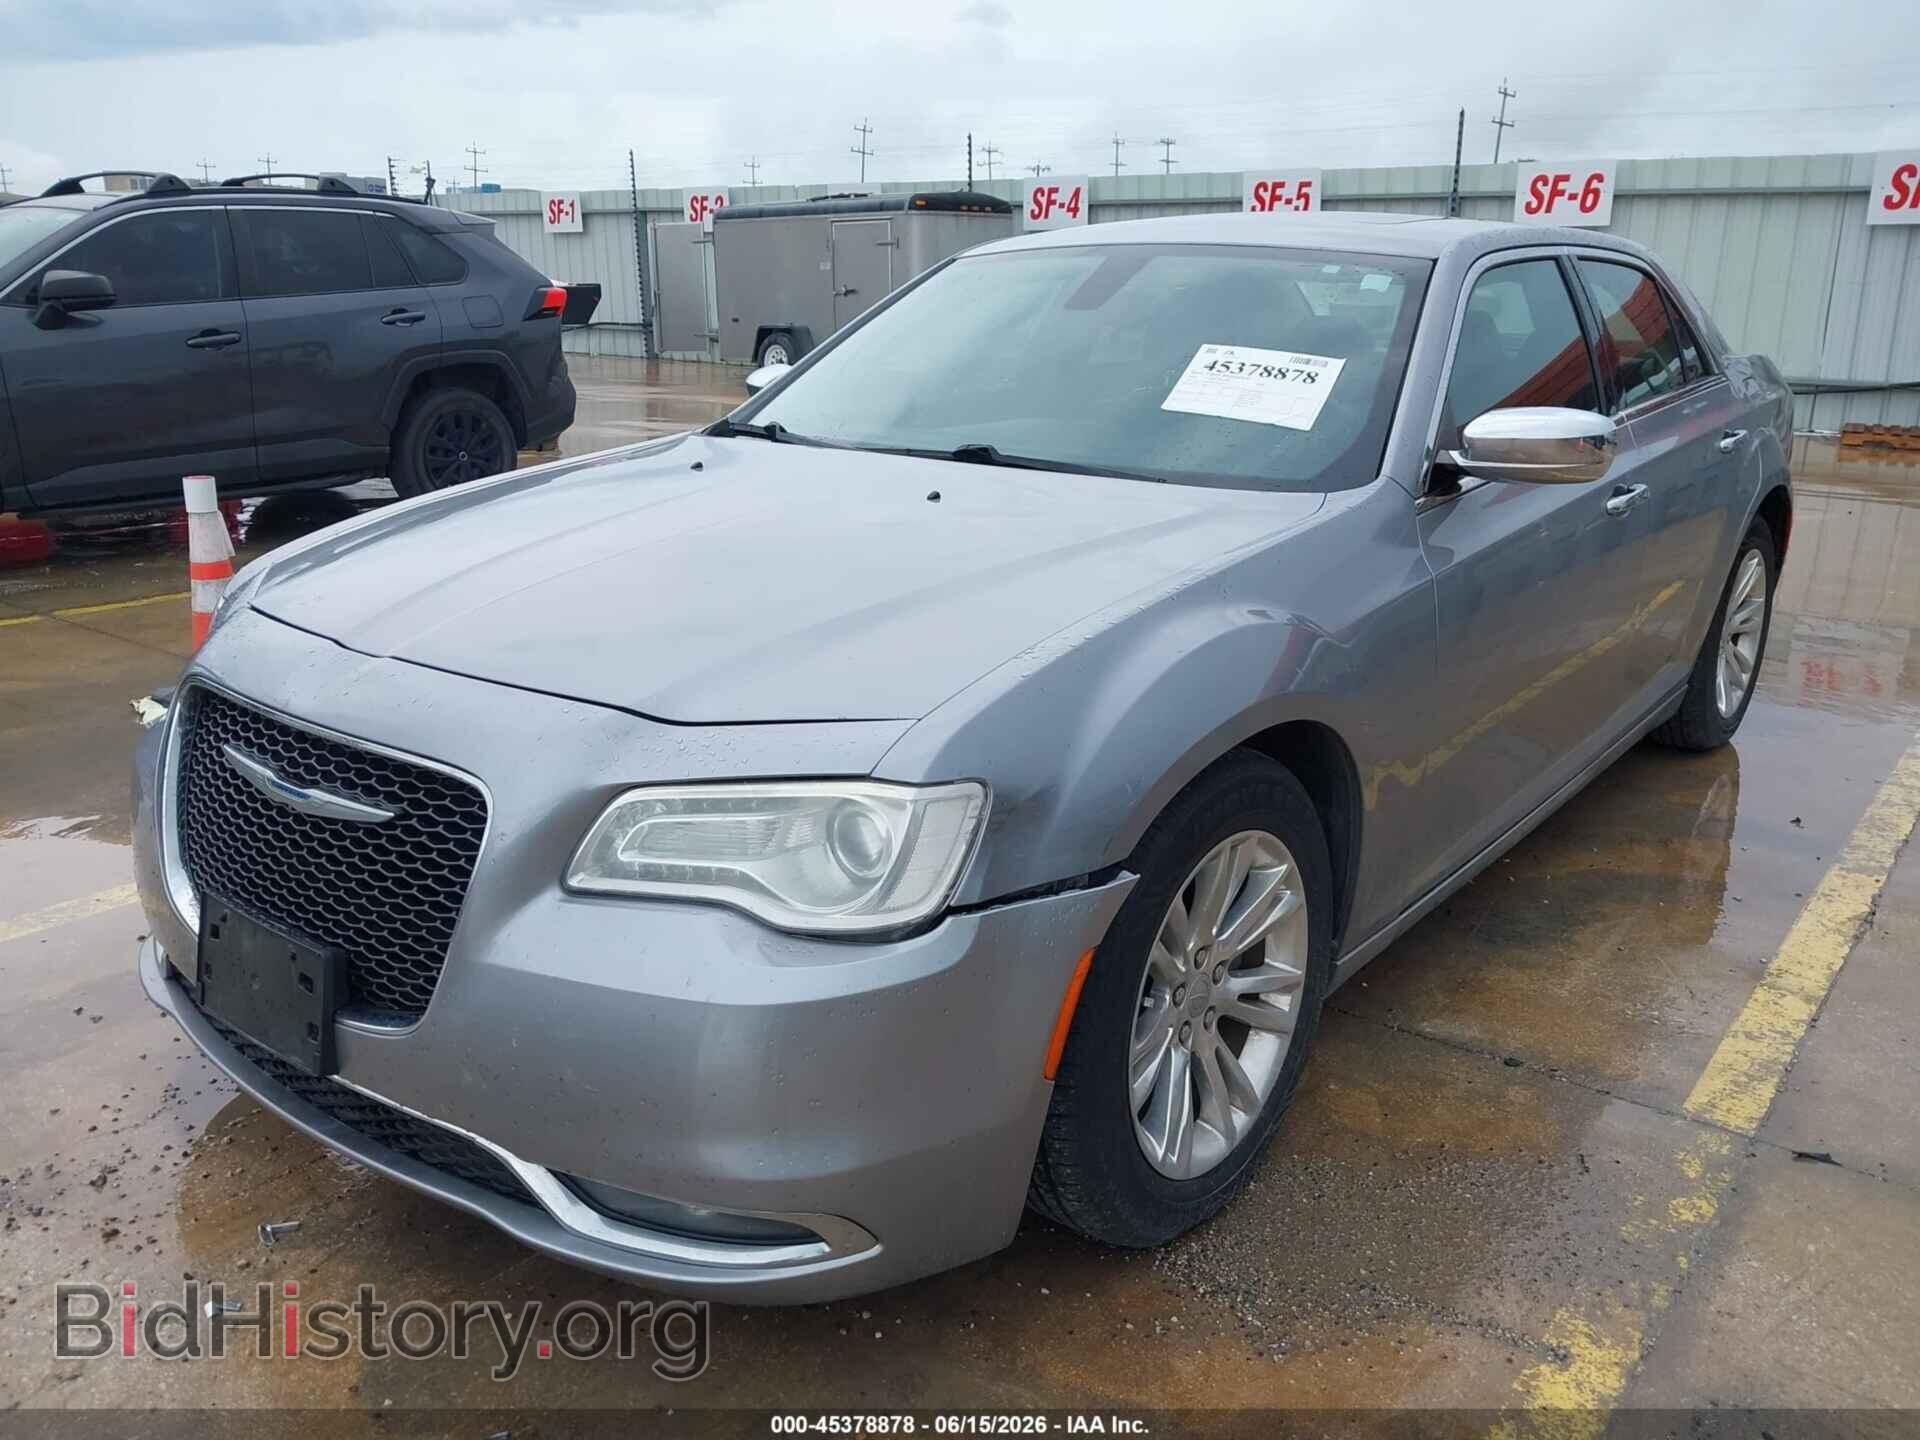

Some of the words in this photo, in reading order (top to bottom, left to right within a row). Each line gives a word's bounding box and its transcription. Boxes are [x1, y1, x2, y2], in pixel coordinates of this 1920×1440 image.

[1030, 186, 1081, 221] SF-4
[1250, 181, 1312, 212] SF-5
[1524, 172, 1605, 215] SF-6
[548, 197, 577, 225] SF-1
[1203, 359, 1319, 385] 45378878
